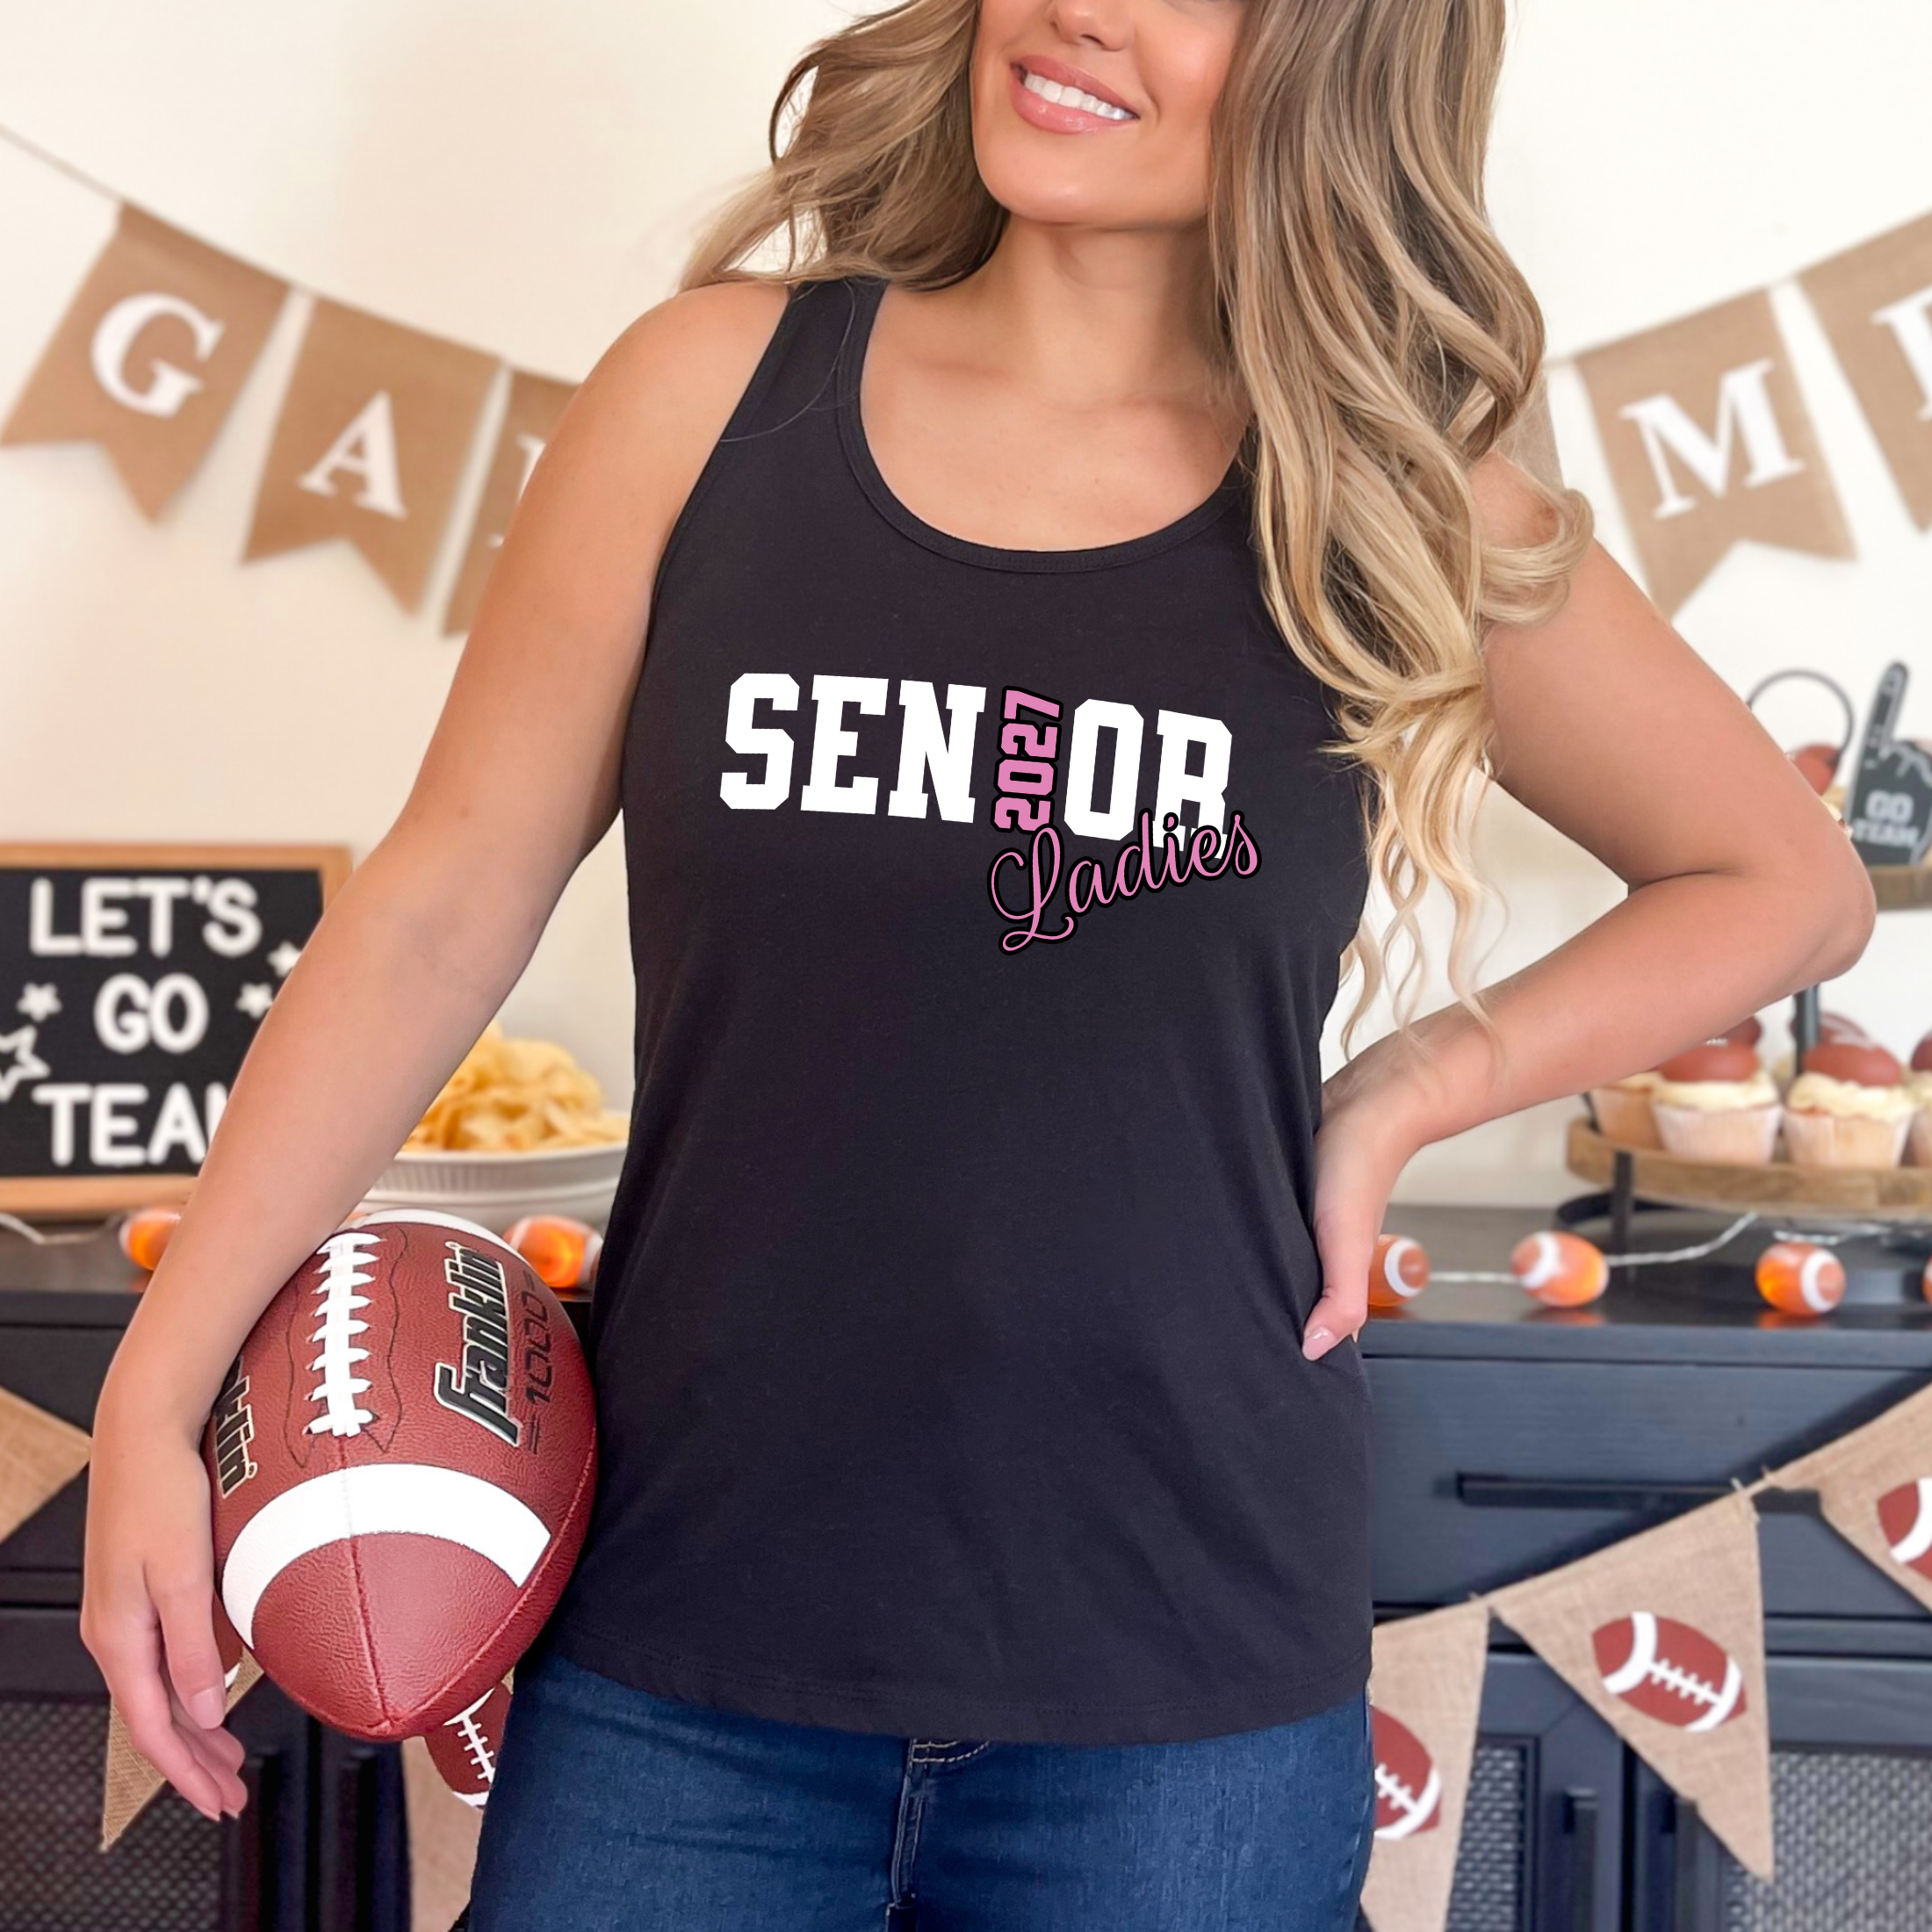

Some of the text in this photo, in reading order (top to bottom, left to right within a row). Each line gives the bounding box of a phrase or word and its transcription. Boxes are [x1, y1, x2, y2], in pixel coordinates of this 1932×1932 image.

[991, 688, 1061, 833] 2027
[29, 877, 262, 957] LET'S
[990, 810, 1261, 953] Ladies
[94, 972, 209, 1053] GO
